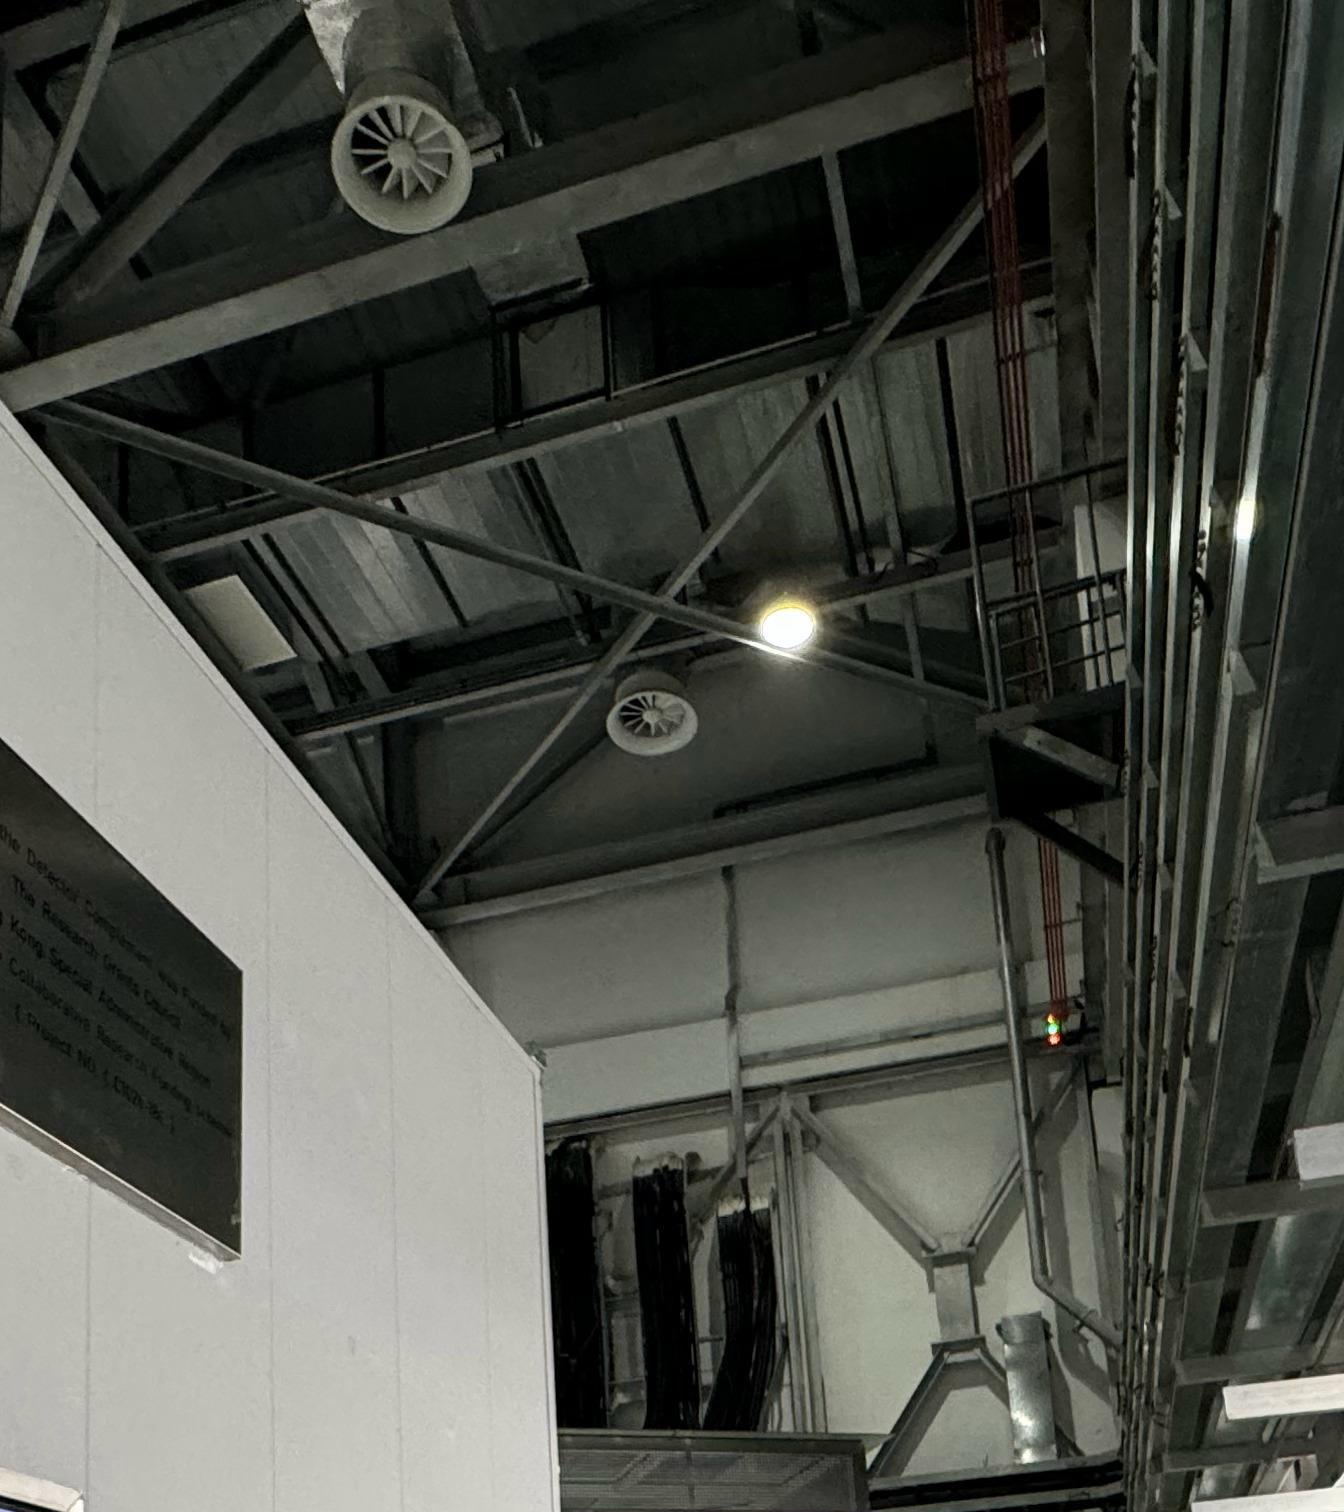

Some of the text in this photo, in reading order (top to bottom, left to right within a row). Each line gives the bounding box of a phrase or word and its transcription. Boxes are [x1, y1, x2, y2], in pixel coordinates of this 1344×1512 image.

[0, 822, 20, 855] the
[13, 875, 35, 910] The
[9, 913, 43, 961] Kong
